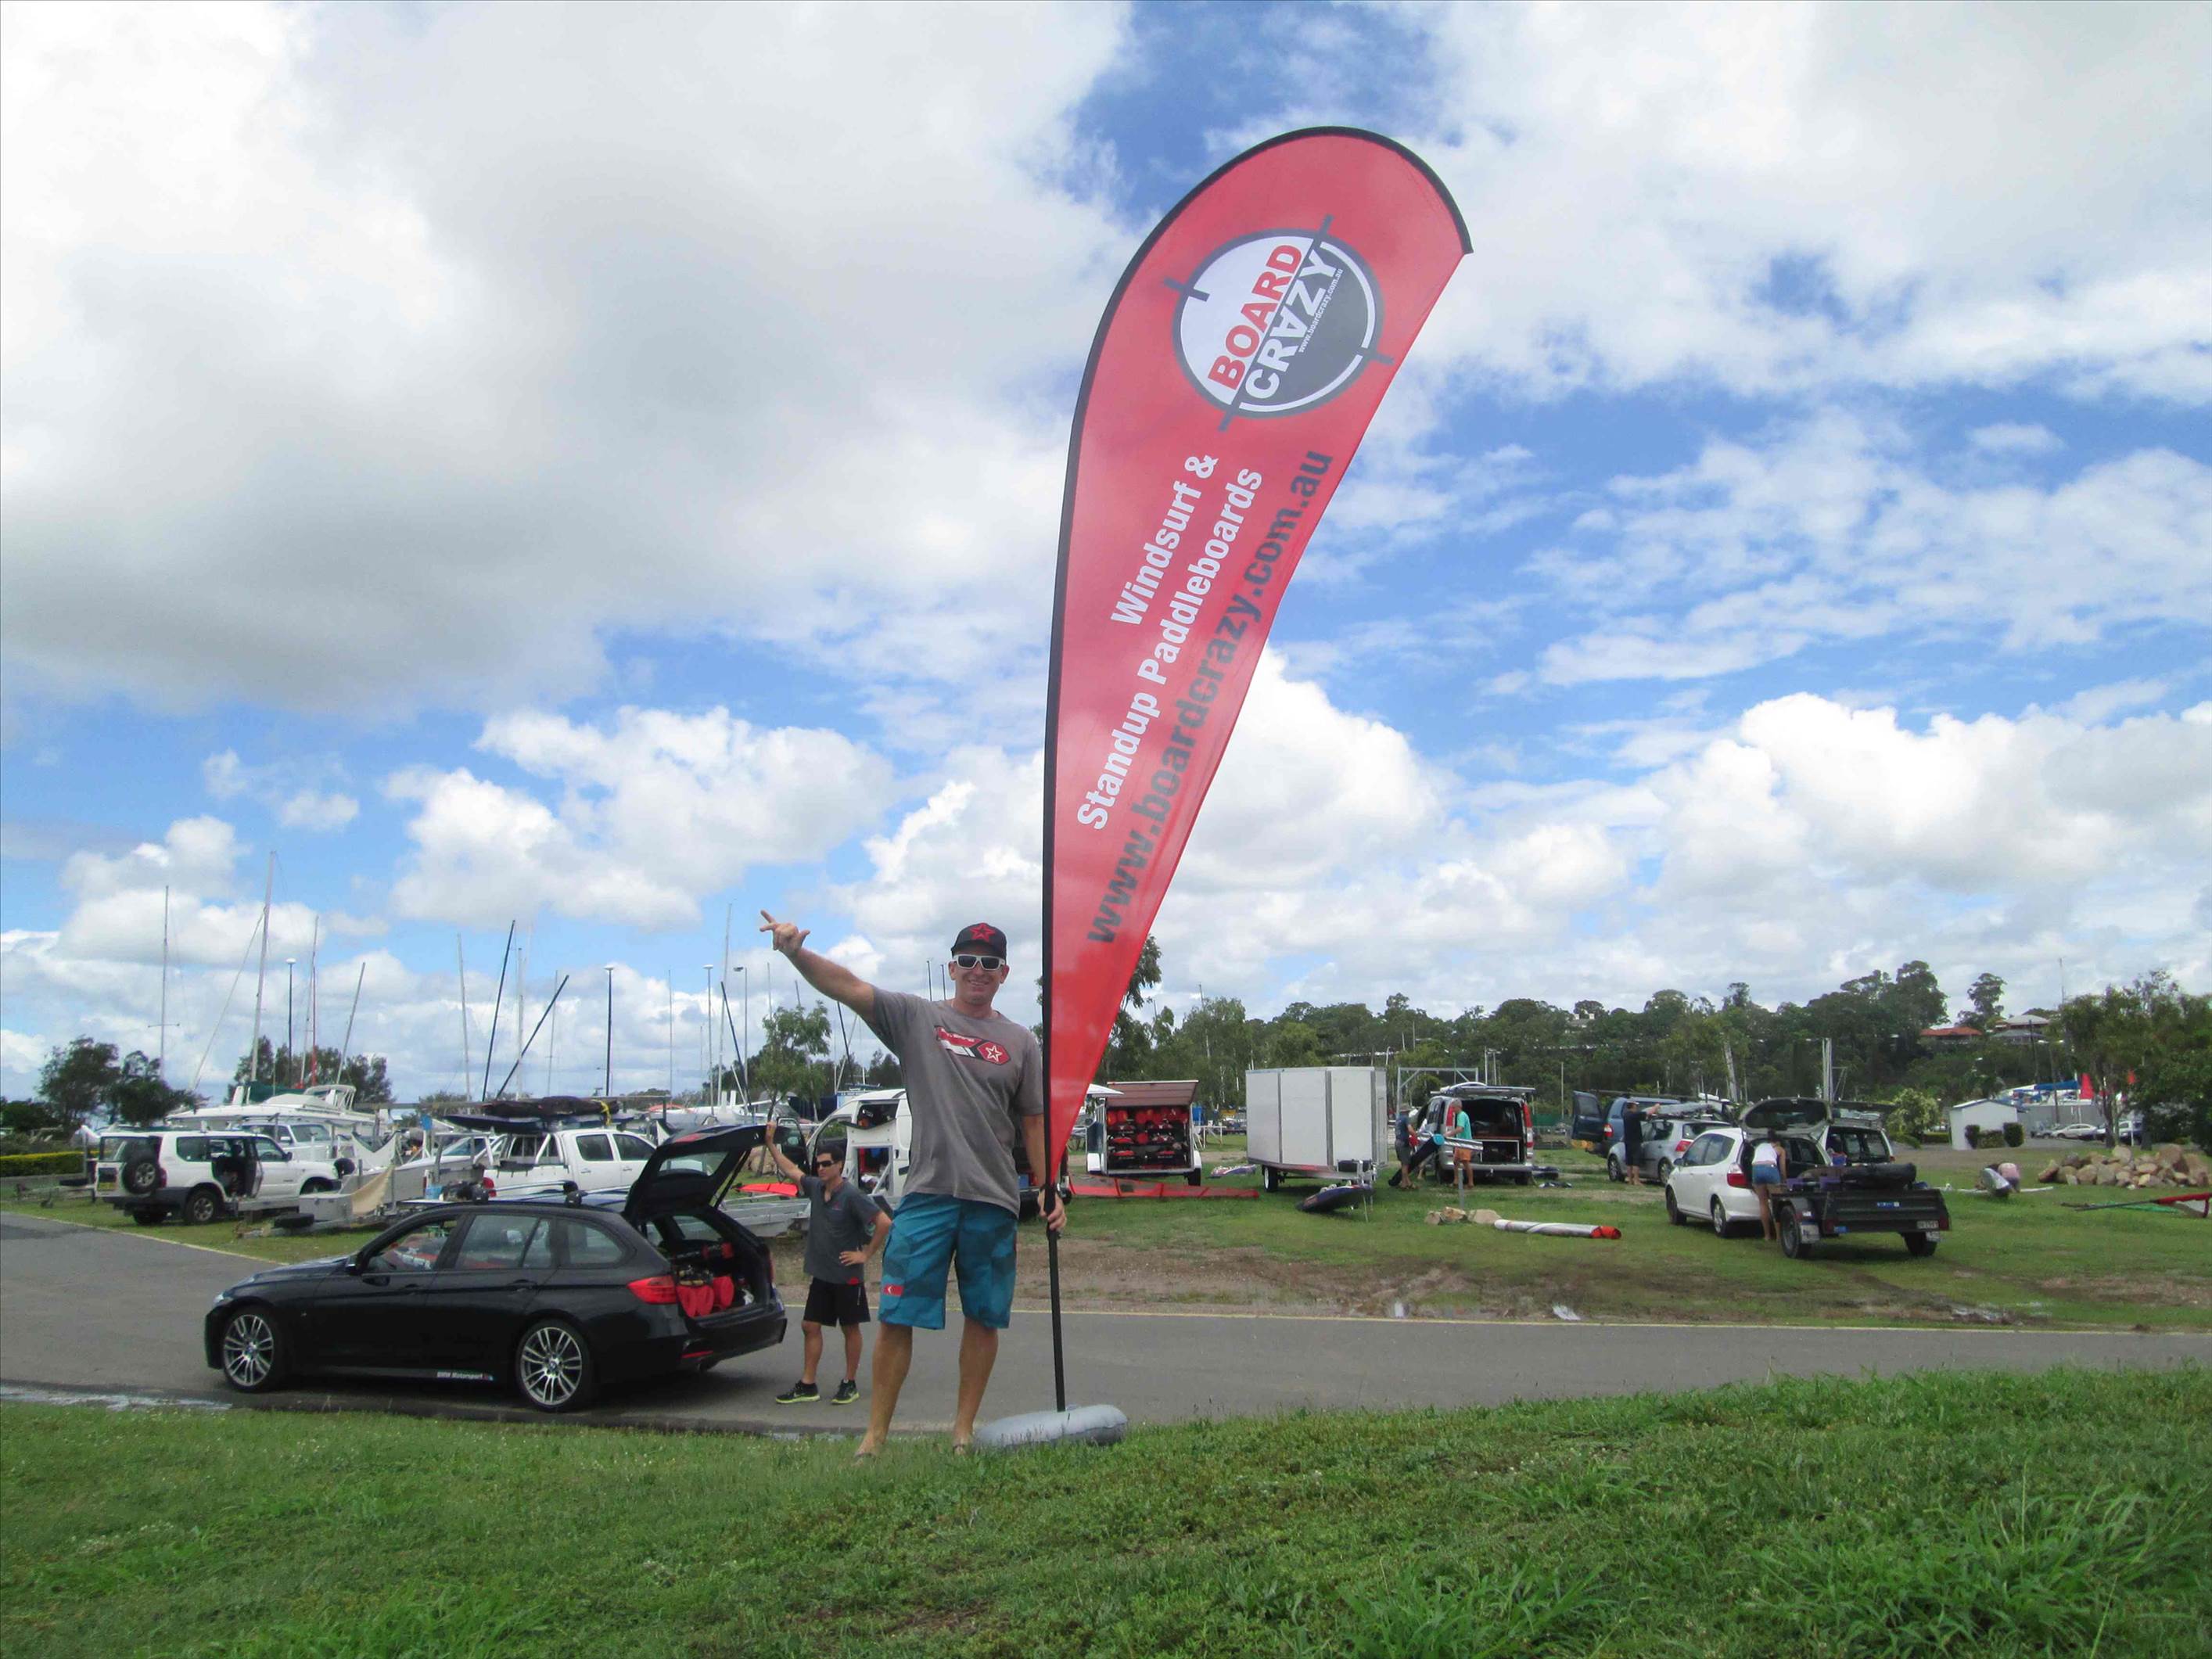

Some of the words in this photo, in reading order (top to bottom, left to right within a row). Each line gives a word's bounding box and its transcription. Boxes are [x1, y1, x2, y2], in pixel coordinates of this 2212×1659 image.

[1208, 245, 1302, 390] BOARD
[1245, 250, 1338, 399] CRAZY
[1298, 268, 1344, 354] www.boardcrazy.com.au
[1110, 479, 1202, 625] Windsurf
[1184, 454, 1219, 479] &
[1077, 692, 1162, 830] Standup
[1137, 469, 1262, 685] Paddleboards
[1087, 451, 1334, 943] www.boardcrazy.com.au
